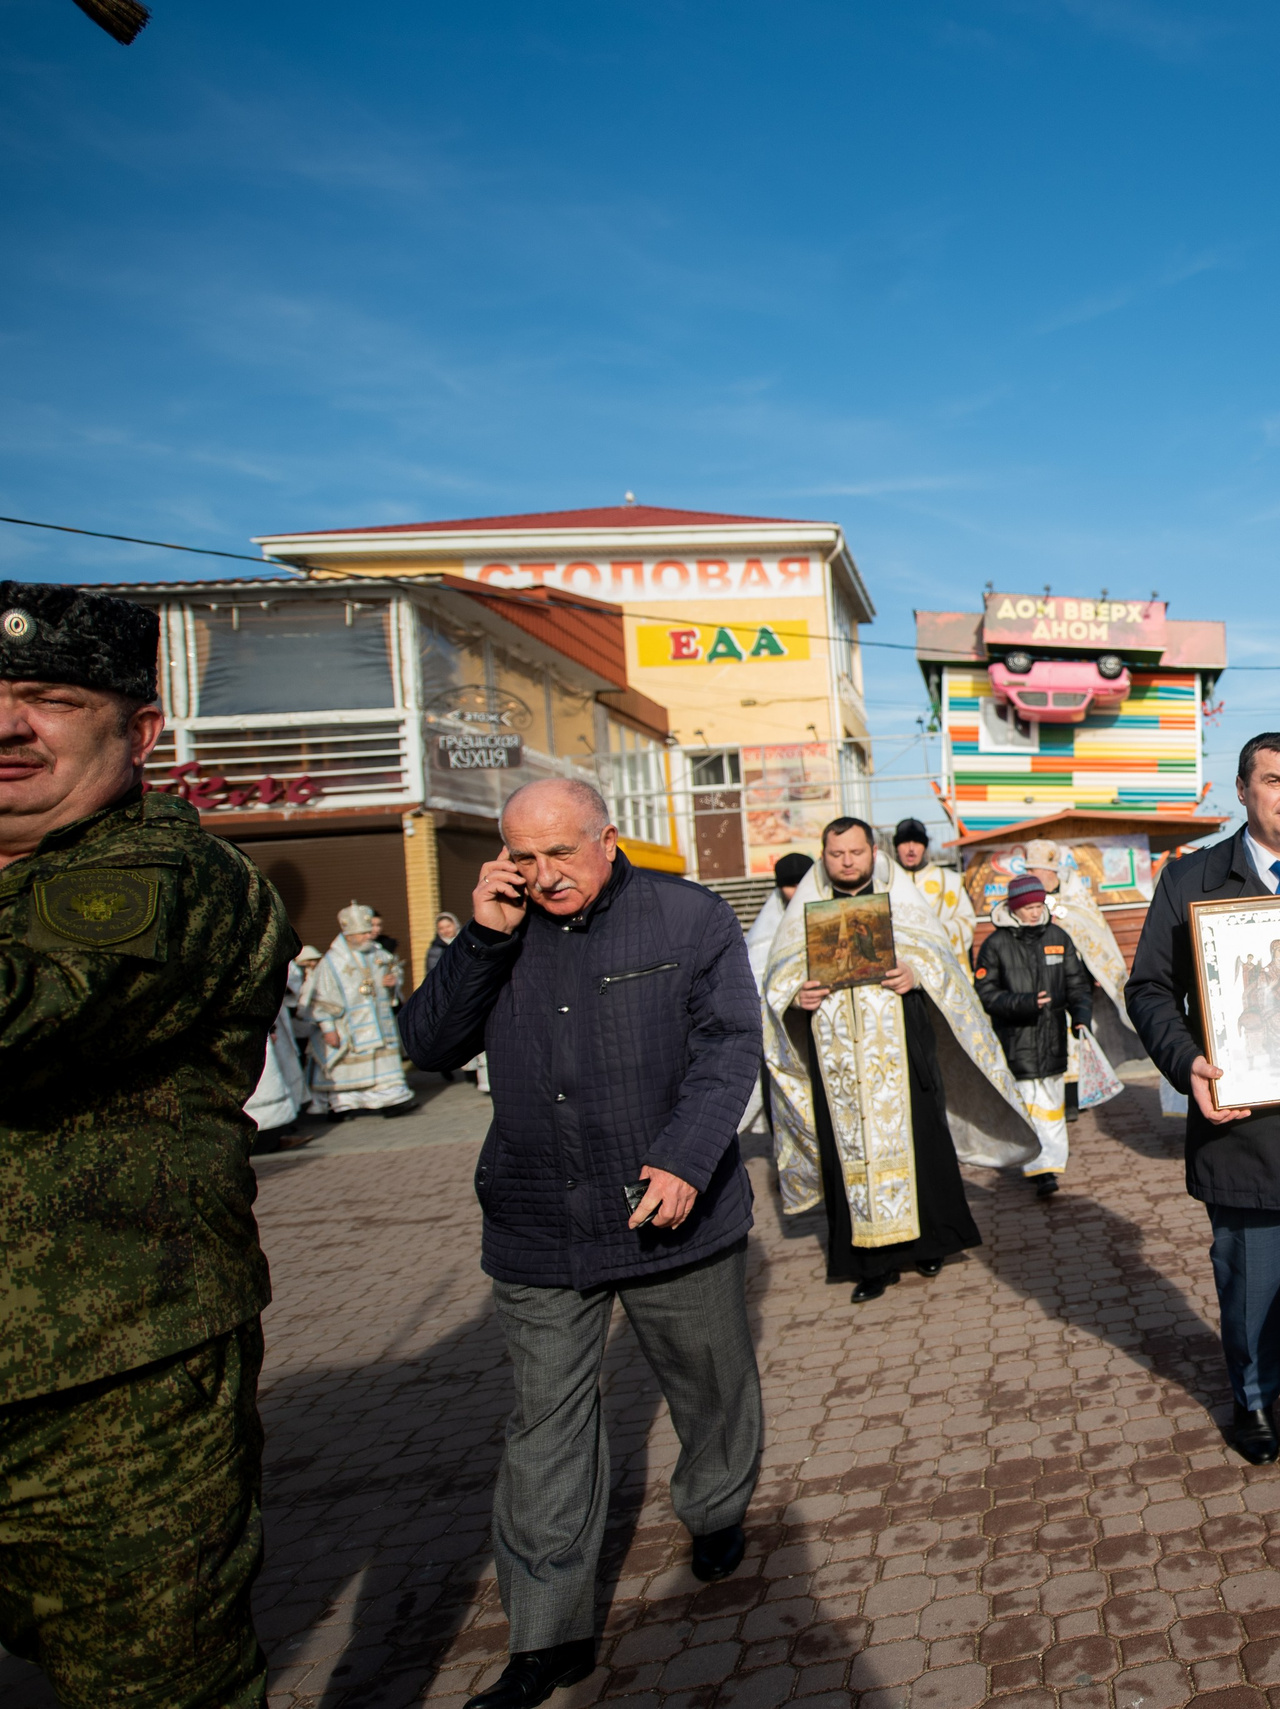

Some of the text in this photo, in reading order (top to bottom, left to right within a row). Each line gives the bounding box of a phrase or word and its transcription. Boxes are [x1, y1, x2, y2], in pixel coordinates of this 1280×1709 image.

[996, 598, 1144, 623] ДОМ ВВЕРХ
[1032, 620, 1108, 642] ДНОМ
[669, 626, 786, 664] ЕДА
[448, 748, 509, 769] КУХНЯ
[70, 874, 123, 883] РОССИЯ
